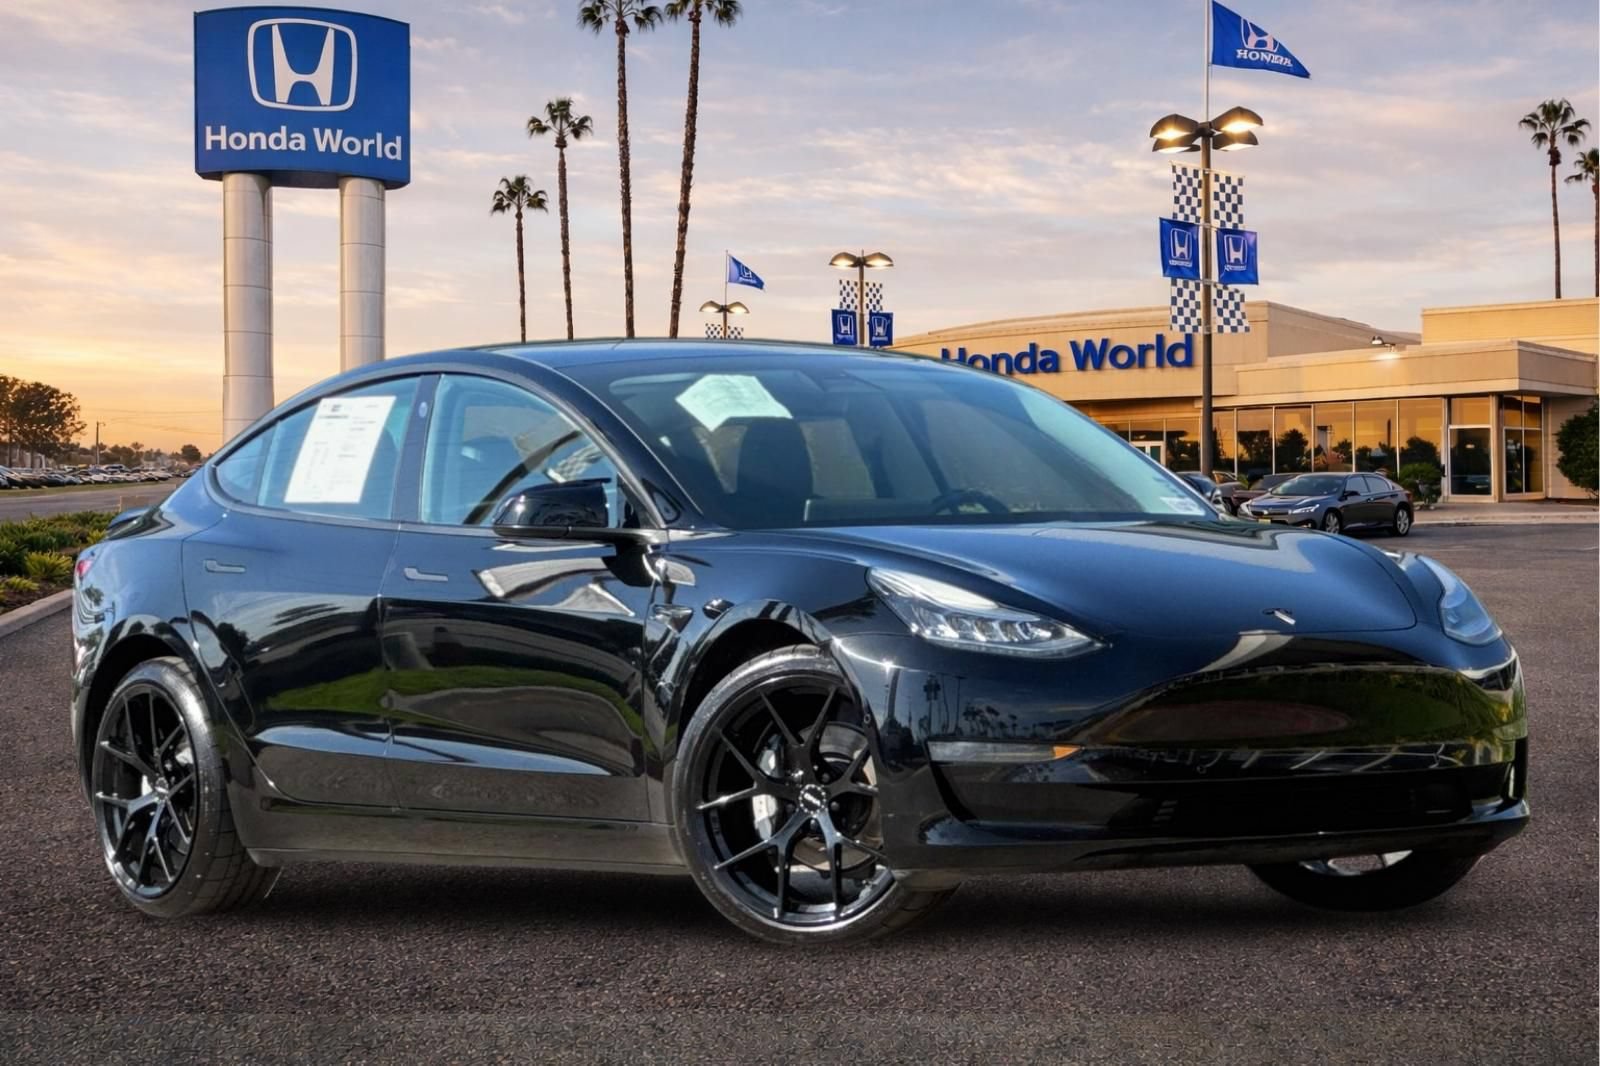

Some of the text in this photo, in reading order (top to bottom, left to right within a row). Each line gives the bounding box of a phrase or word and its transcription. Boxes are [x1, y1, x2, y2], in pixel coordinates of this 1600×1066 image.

[205, 125, 402, 160] Honda World
[1069, 333, 1193, 371] World
